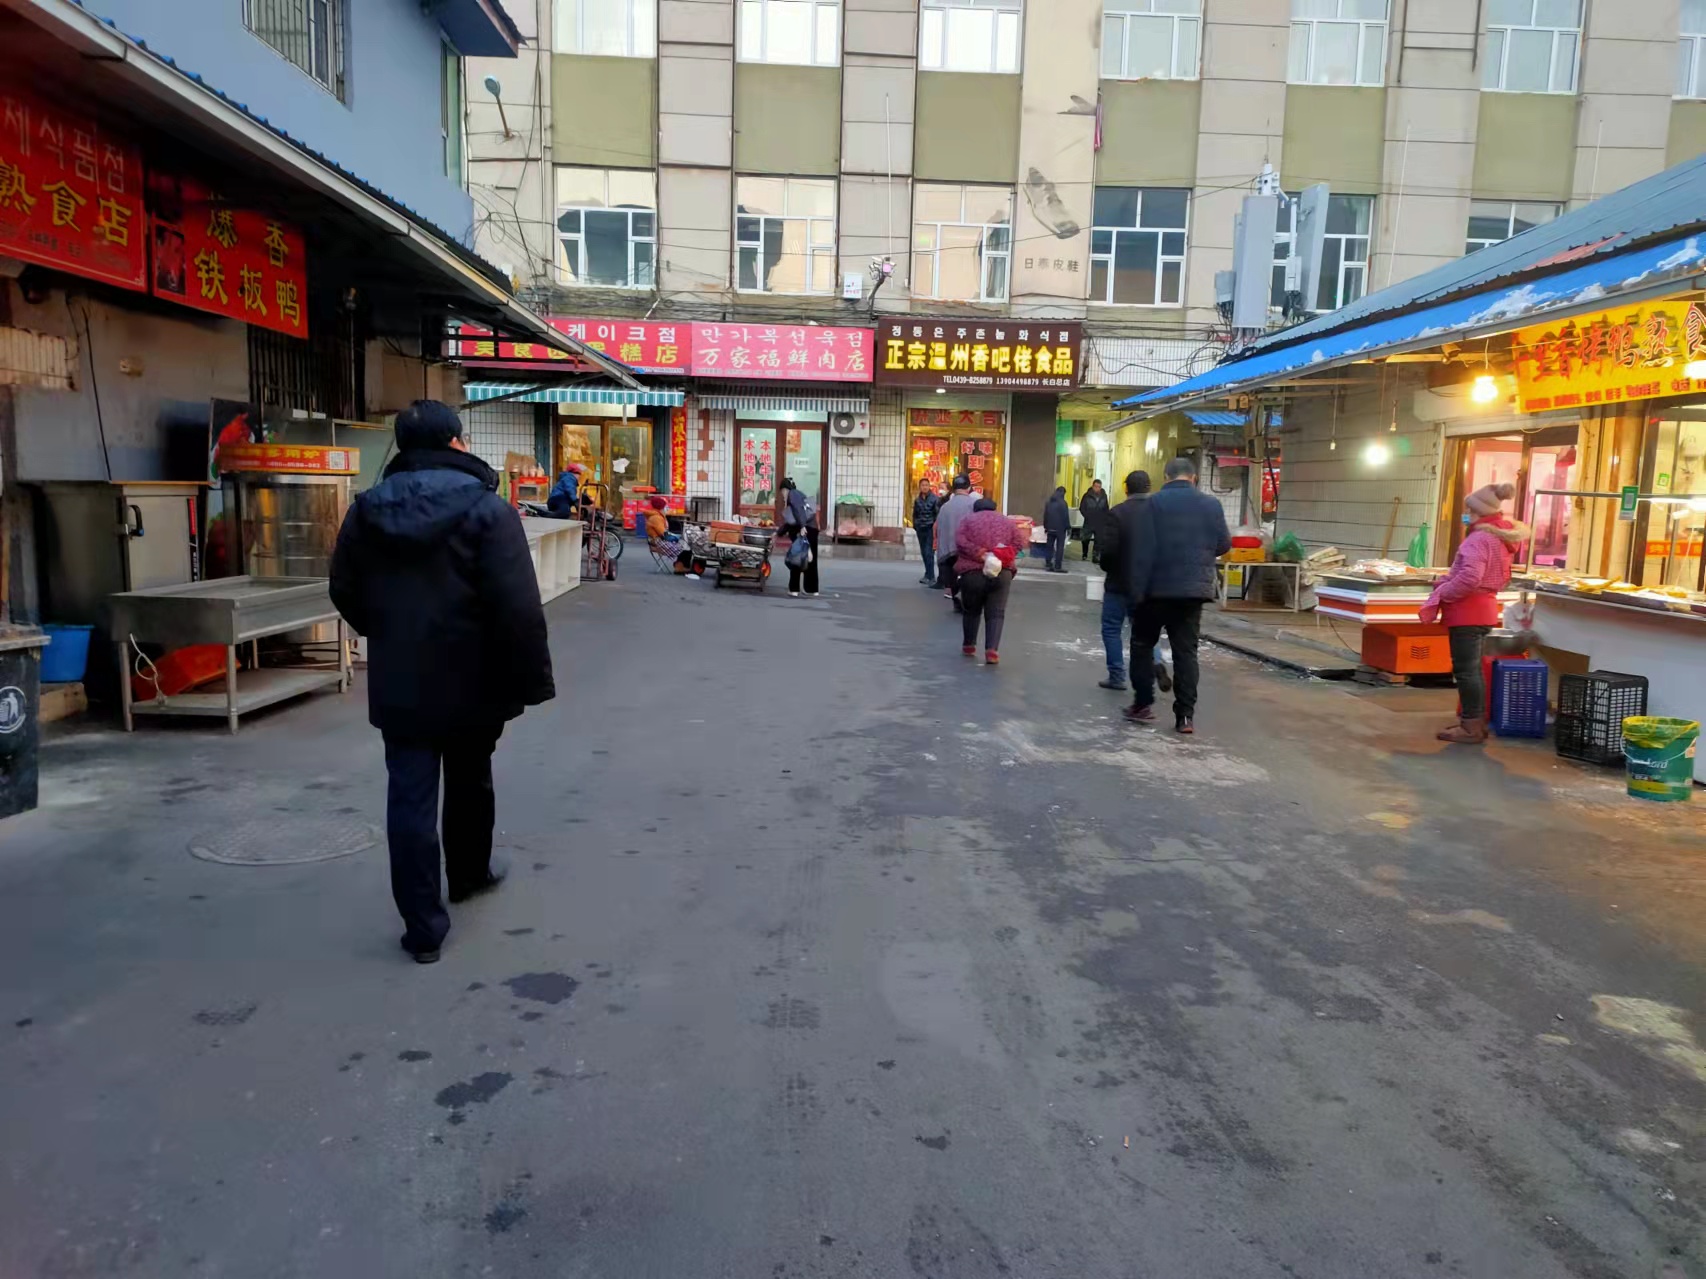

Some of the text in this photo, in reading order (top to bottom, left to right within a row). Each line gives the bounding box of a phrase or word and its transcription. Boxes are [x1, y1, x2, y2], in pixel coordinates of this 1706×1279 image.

[193, 247, 300, 328] 铁板鸭
[699, 346, 865, 372] 万家福鲜肉店
[885, 339, 1074, 375] 正宗温州香吧佬食品
[743, 439, 755, 490] 本地猪肉
[759, 440, 772, 490] 本地牛肉
